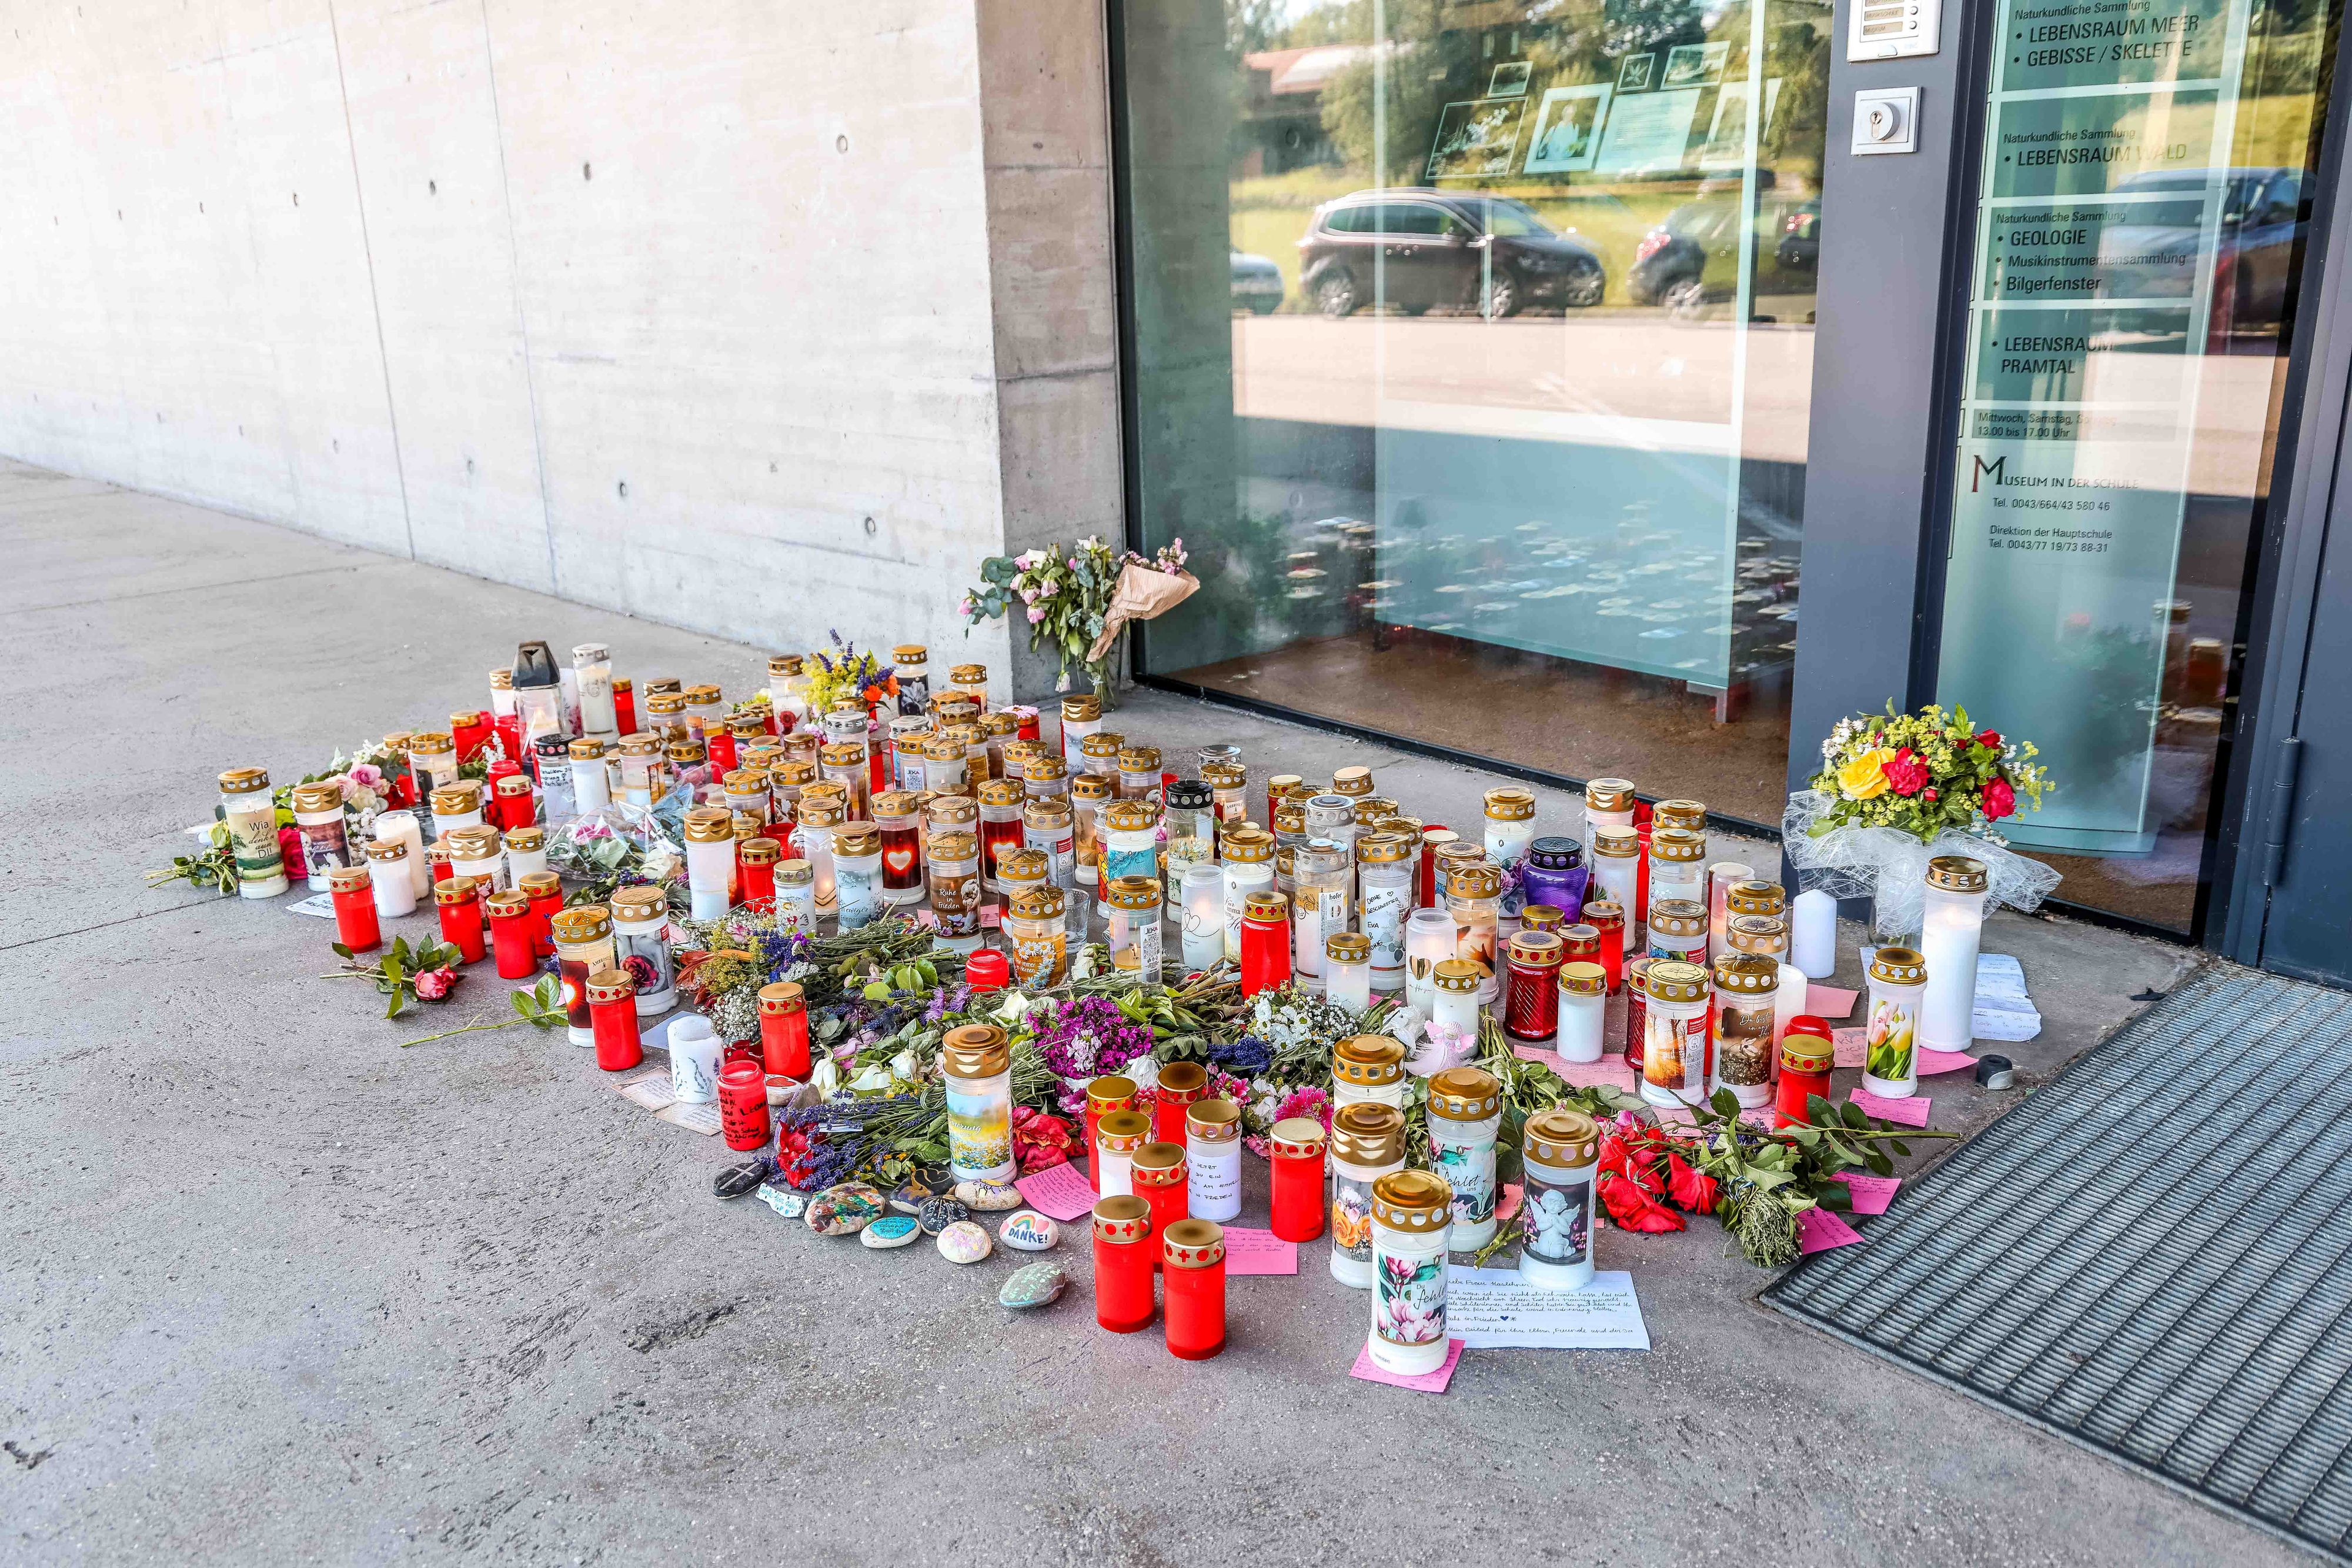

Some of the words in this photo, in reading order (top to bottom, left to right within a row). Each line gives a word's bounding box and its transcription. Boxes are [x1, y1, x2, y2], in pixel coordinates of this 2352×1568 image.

[2014, 4, 2091, 21] Naturkundliche
[2094, 0, 2150, 14] Sammlung
[2029, 18, 2146, 43] LEBENSRAUM
[2151, 15, 2200, 34] MEER
[2027, 46, 2096, 67] GEBISSE
[2097, 45, 2108, 64] /
[2111, 40, 2193, 60] SKELETTE
[2003, 131, 2077, 144] Naturkundliche
[2080, 128, 2136, 141] Sammlung
[2018, 146, 2131, 167] LEBENSRAUM
[1997, 212, 2070, 224] Naturkundliche
[2072, 210, 2127, 223] Sammlung
[2010, 229, 2087, 247] GEOLOGIE
[2008, 252, 2187, 268] Musikinstrumentensammlung
[2006, 276, 2102, 292] Bilgerfenster
[2004, 336, 2114, 353] LEBENSRAUM
[2000, 359, 2076, 375] PRAMTAL
[1978, 411, 2025, 424] Mittwoch,
[2029, 413, 2074, 426] Samstag,
[1978, 426, 2003, 437] 13.00
[2005, 427, 2020, 437] bis
[2023, 427, 2050, 438] 17.00
[2052, 427, 2071, 439] Uhr
[1972, 454, 2048, 493] MUSEUM
[2052, 477, 2064, 487] IN
[2068, 478, 2090, 489] DER
[2094, 479, 2140, 489] SCHULE
[1993, 497, 2009, 509] Tel.
[2011, 499, 2074, 510] 0043/664/43
[2076, 500, 2096, 511] 580
[2098, 502, 2111, 511] 46
[1989, 524, 2032, 536] Direktion
[2034, 527, 2050, 537] der
[2052, 527, 2113, 540] Hauptschule
[1988, 538, 2004, 549] Tel.
[2007, 539, 2047, 551] 0043/77
[2051, 541, 2078, 552] 19/73
[2080, 543, 2109, 553] 88-31
[249, 820, 269, 831] Wia
[939, 888, 956, 897] Ruhe
[1367, 894, 1381, 905] DEINE
[938, 901, 960, 910] Frieden
[1367, 897, 1399, 915] GESCHWISTER
[1145, 926, 1158, 935] JEKA
[1739, 1014, 1755, 1026] Du
[1188, 1177, 1197, 1186] ERN
[1008, 1228, 1048, 1244] DANKE!
